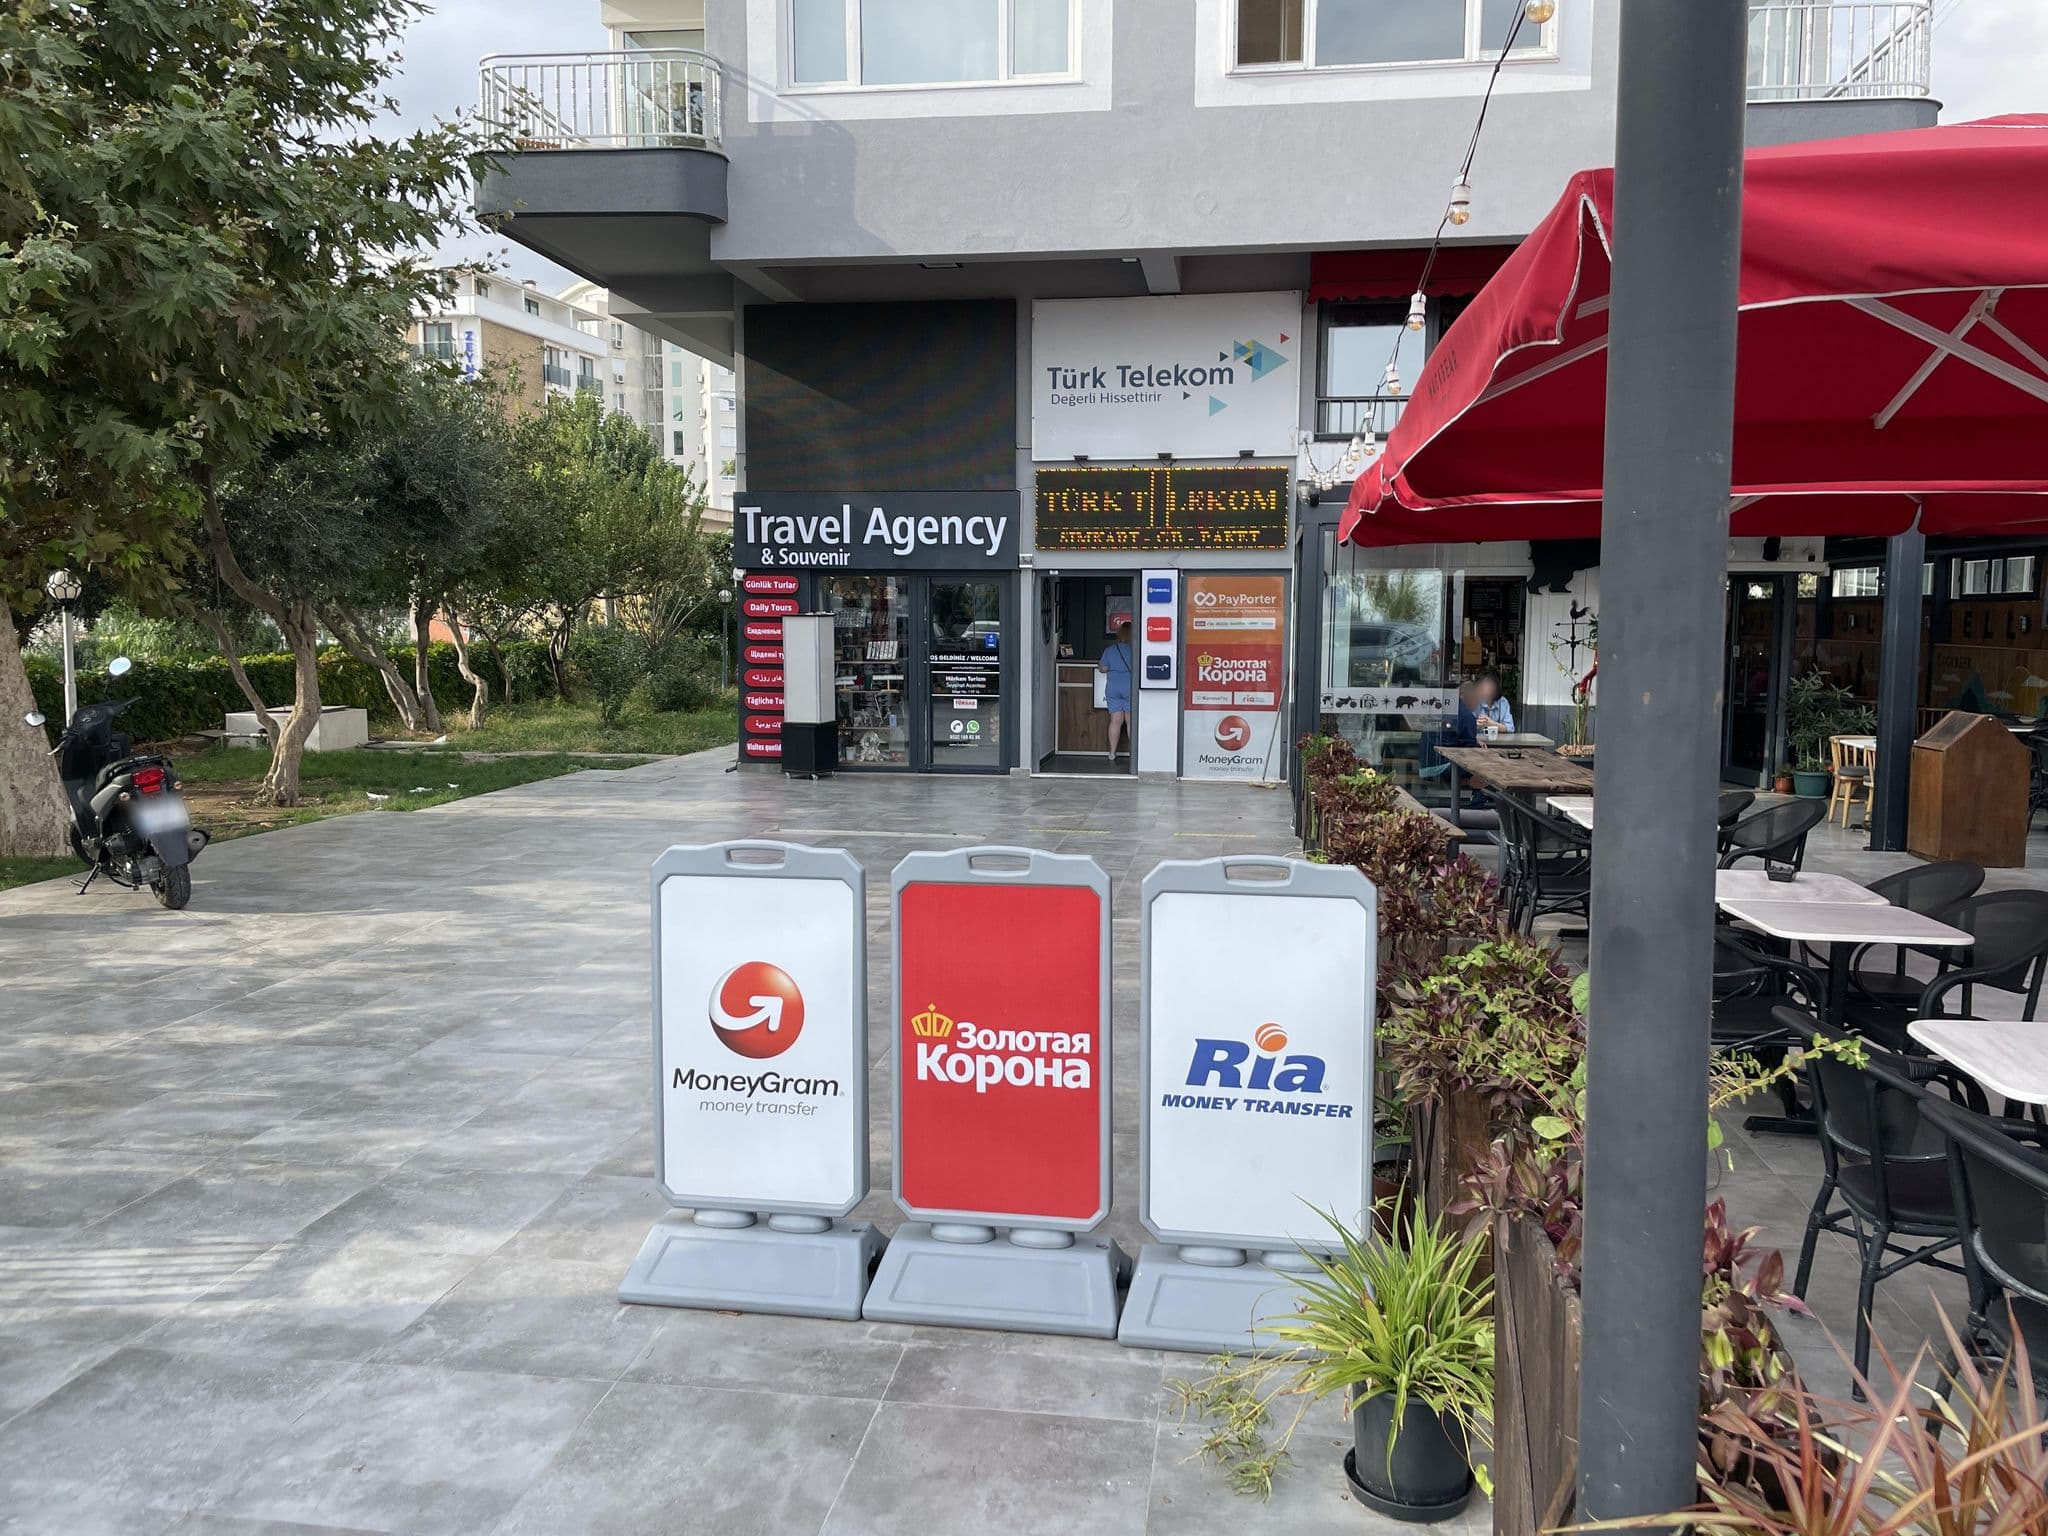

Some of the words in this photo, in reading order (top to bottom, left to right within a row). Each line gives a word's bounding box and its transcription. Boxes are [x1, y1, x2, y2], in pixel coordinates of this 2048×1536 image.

[1047, 366, 1106, 389] Türk
[1116, 363, 1234, 388] Telekom
[1051, 393, 1095, 406] Değerli
[1101, 391, 1162, 403] Hissettirir
[1043, 487, 1122, 512] TÜRK
[739, 504, 850, 545] Travel
[863, 507, 1007, 556] Agency
[761, 549, 774, 565] &
[779, 548, 850, 566] Souvenir
[774, 581, 796, 589] Turlar
[750, 604, 769, 612] Daily
[1219, 594, 1277, 606] PayPorter
[1214, 657, 1267, 669] Золотая
[1199, 666, 1266, 685] Корона
[747, 696, 774, 706] Tägliche
[1199, 755, 1263, 766] MoneyGram
[956, 1022, 1091, 1054] Золотая
[1185, 1023, 1326, 1094] Ria
[917, 1043, 1091, 1093] Корона
[673, 1067, 839, 1098] MoneyGram
[700, 1101, 753, 1115] money
[756, 1101, 818, 1116] transfer
[1161, 1094, 1239, 1111] MONEY
[1243, 1099, 1353, 1118] TRANSFER
